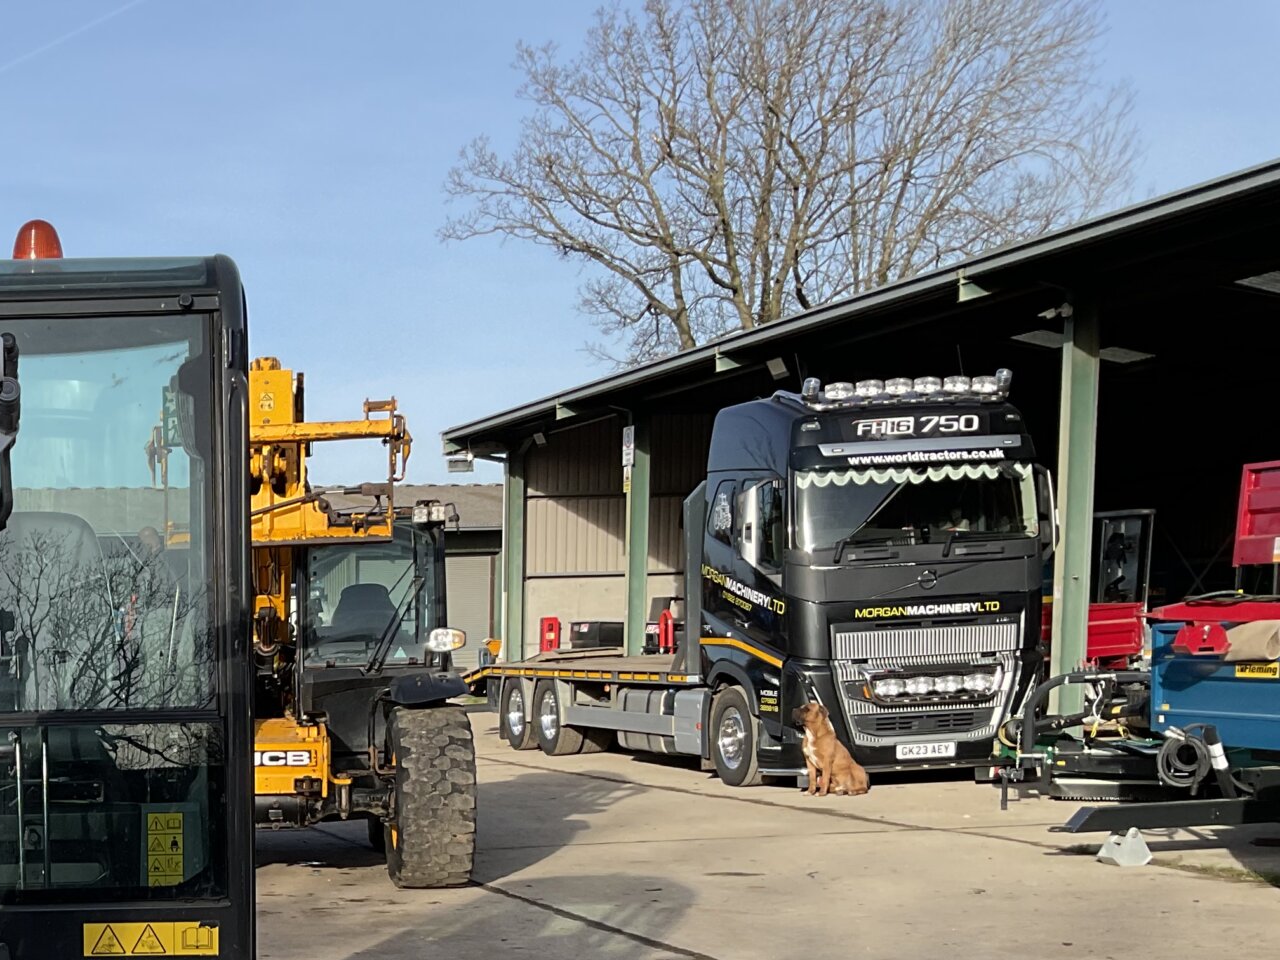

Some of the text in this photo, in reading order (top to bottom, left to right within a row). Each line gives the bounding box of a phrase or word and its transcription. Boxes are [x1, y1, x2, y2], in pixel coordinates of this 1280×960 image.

[920, 414, 979, 433] 750
[847, 448, 1005, 465] www.worldtractors.co.uk
[1244, 664, 1277, 676] Fleming
[901, 744, 950, 756] GK23 AEY
